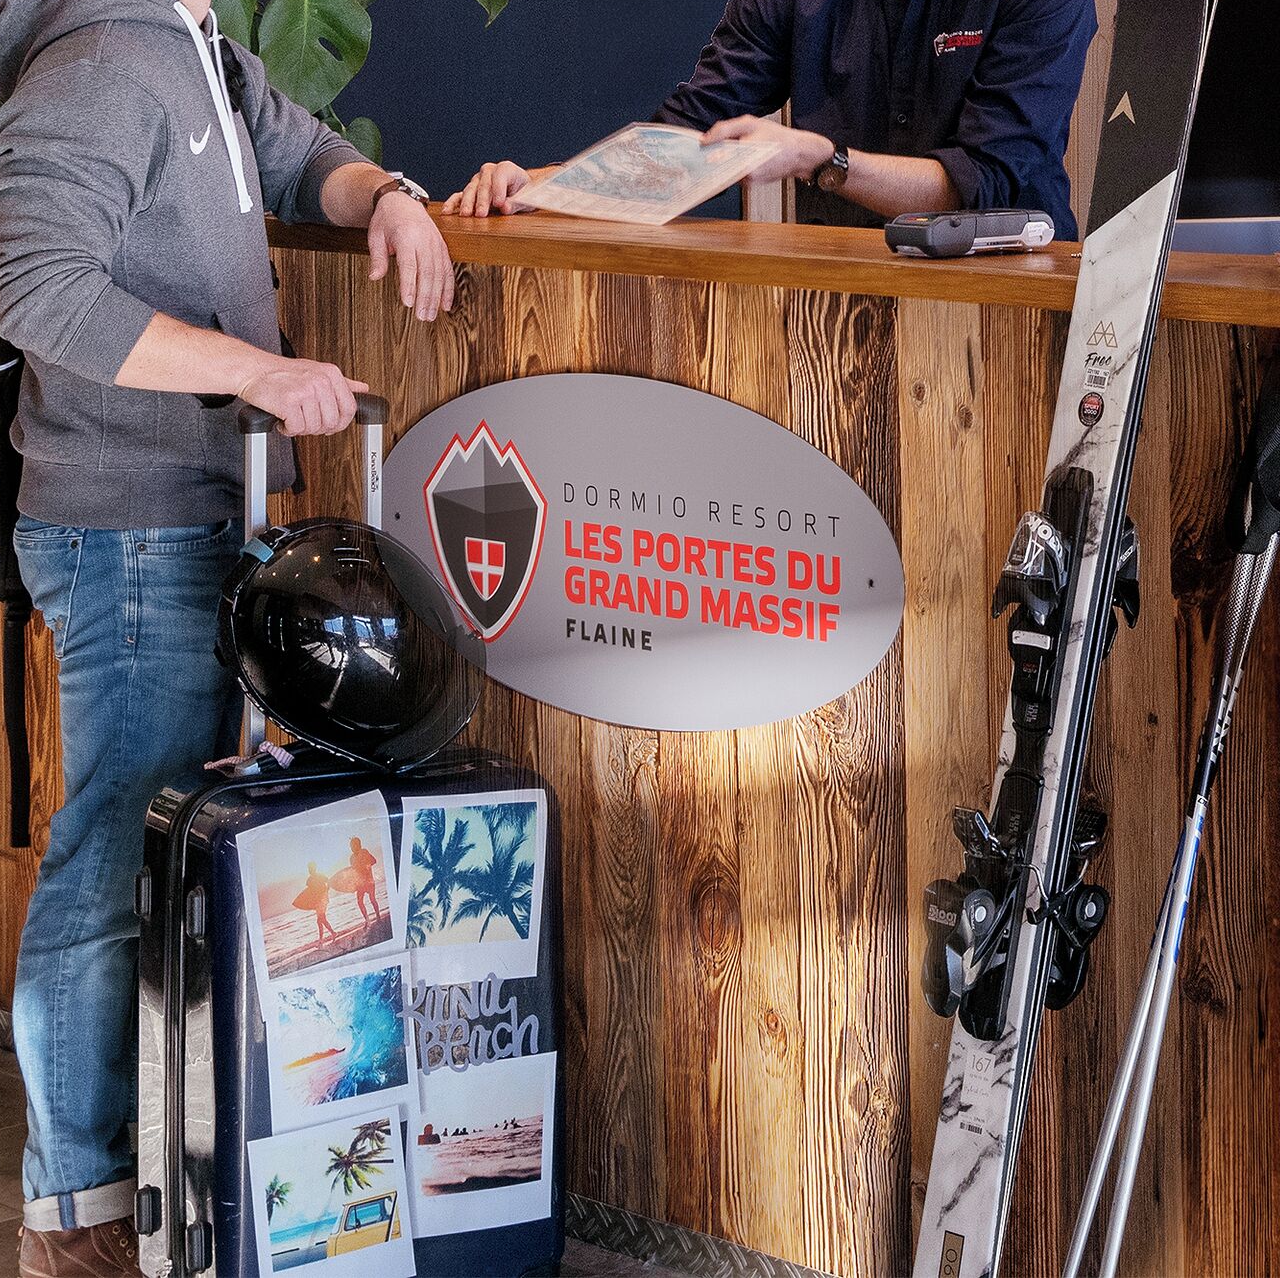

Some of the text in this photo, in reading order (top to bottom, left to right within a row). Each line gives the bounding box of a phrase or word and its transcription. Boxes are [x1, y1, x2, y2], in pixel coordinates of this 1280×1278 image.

[564, 482, 840, 537] DORMIO RESORT
[564, 519, 841, 595] LES PORTES DU
[564, 565, 840, 642] GRAND MASSIF
[566, 618, 652, 651] FLAINE
[971, 1054, 991, 1073] 167
